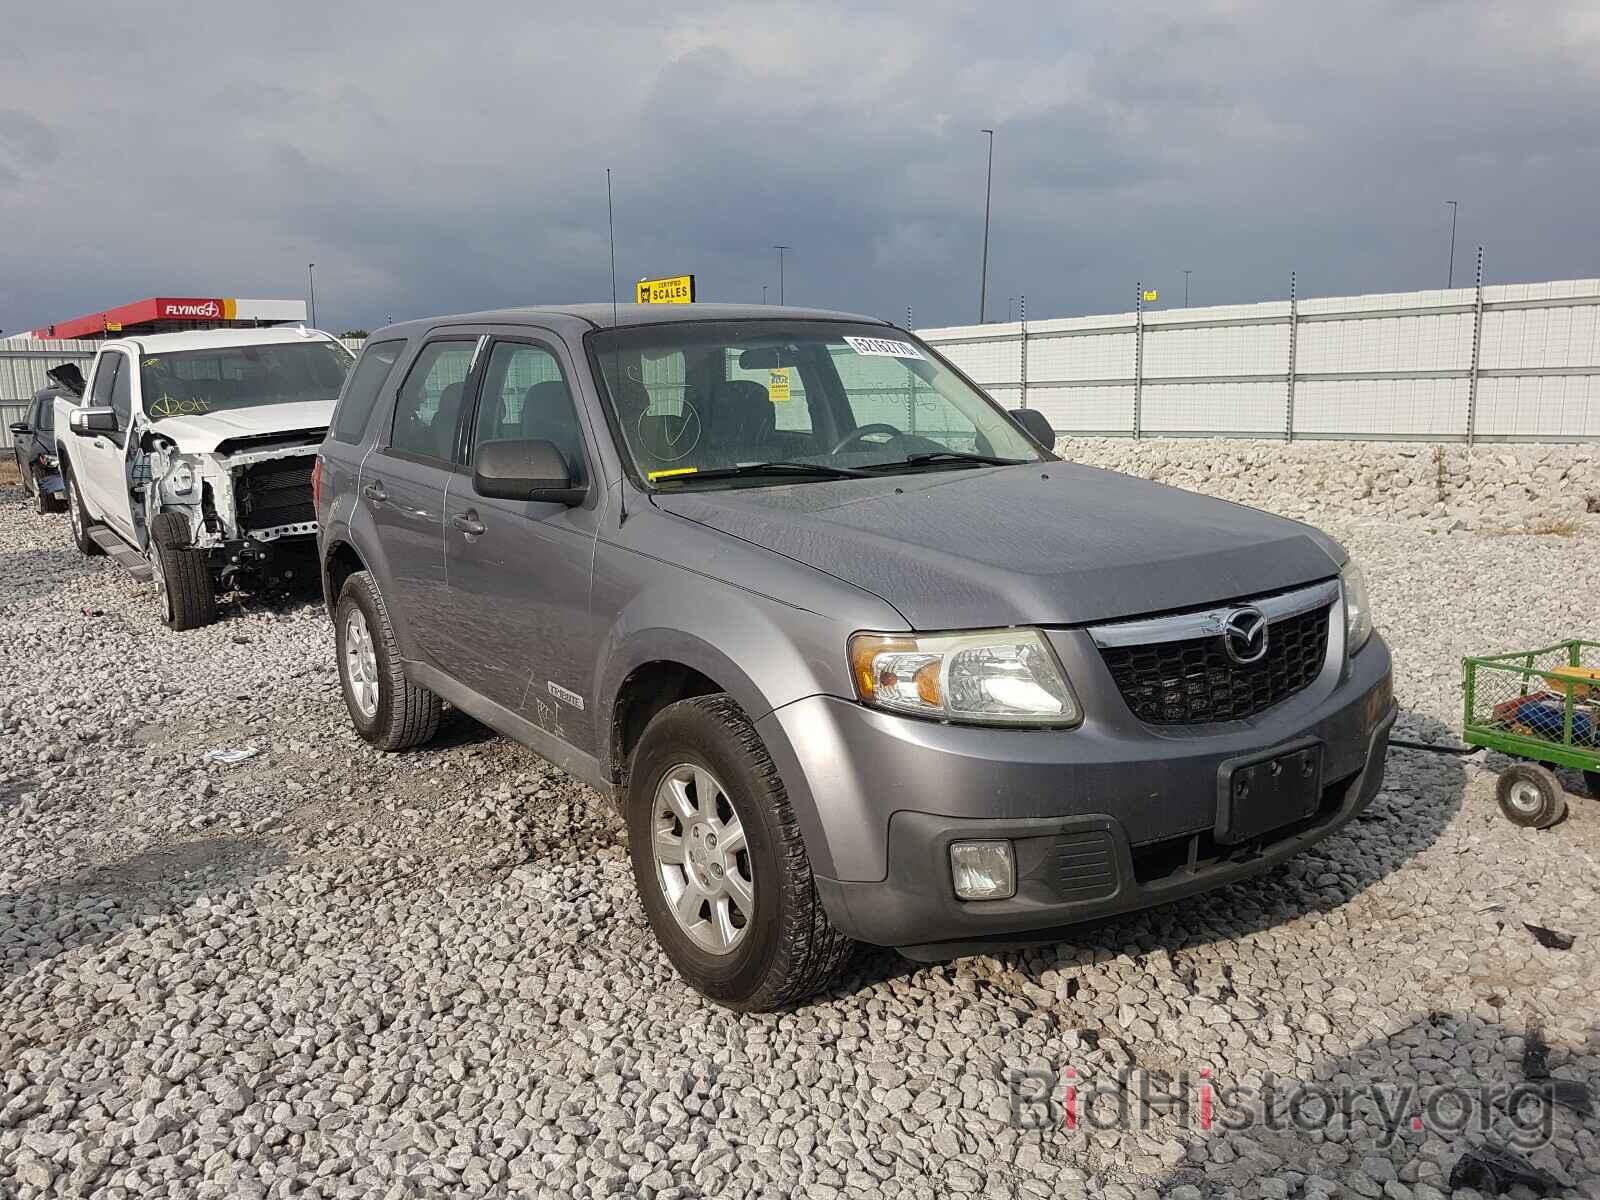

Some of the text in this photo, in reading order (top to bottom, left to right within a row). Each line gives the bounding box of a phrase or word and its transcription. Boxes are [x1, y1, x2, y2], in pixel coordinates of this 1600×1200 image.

[653, 286, 687, 300] SCALES
[166, 305, 205, 315] FLYING
[550, 684, 582, 706] TRIBUTE
